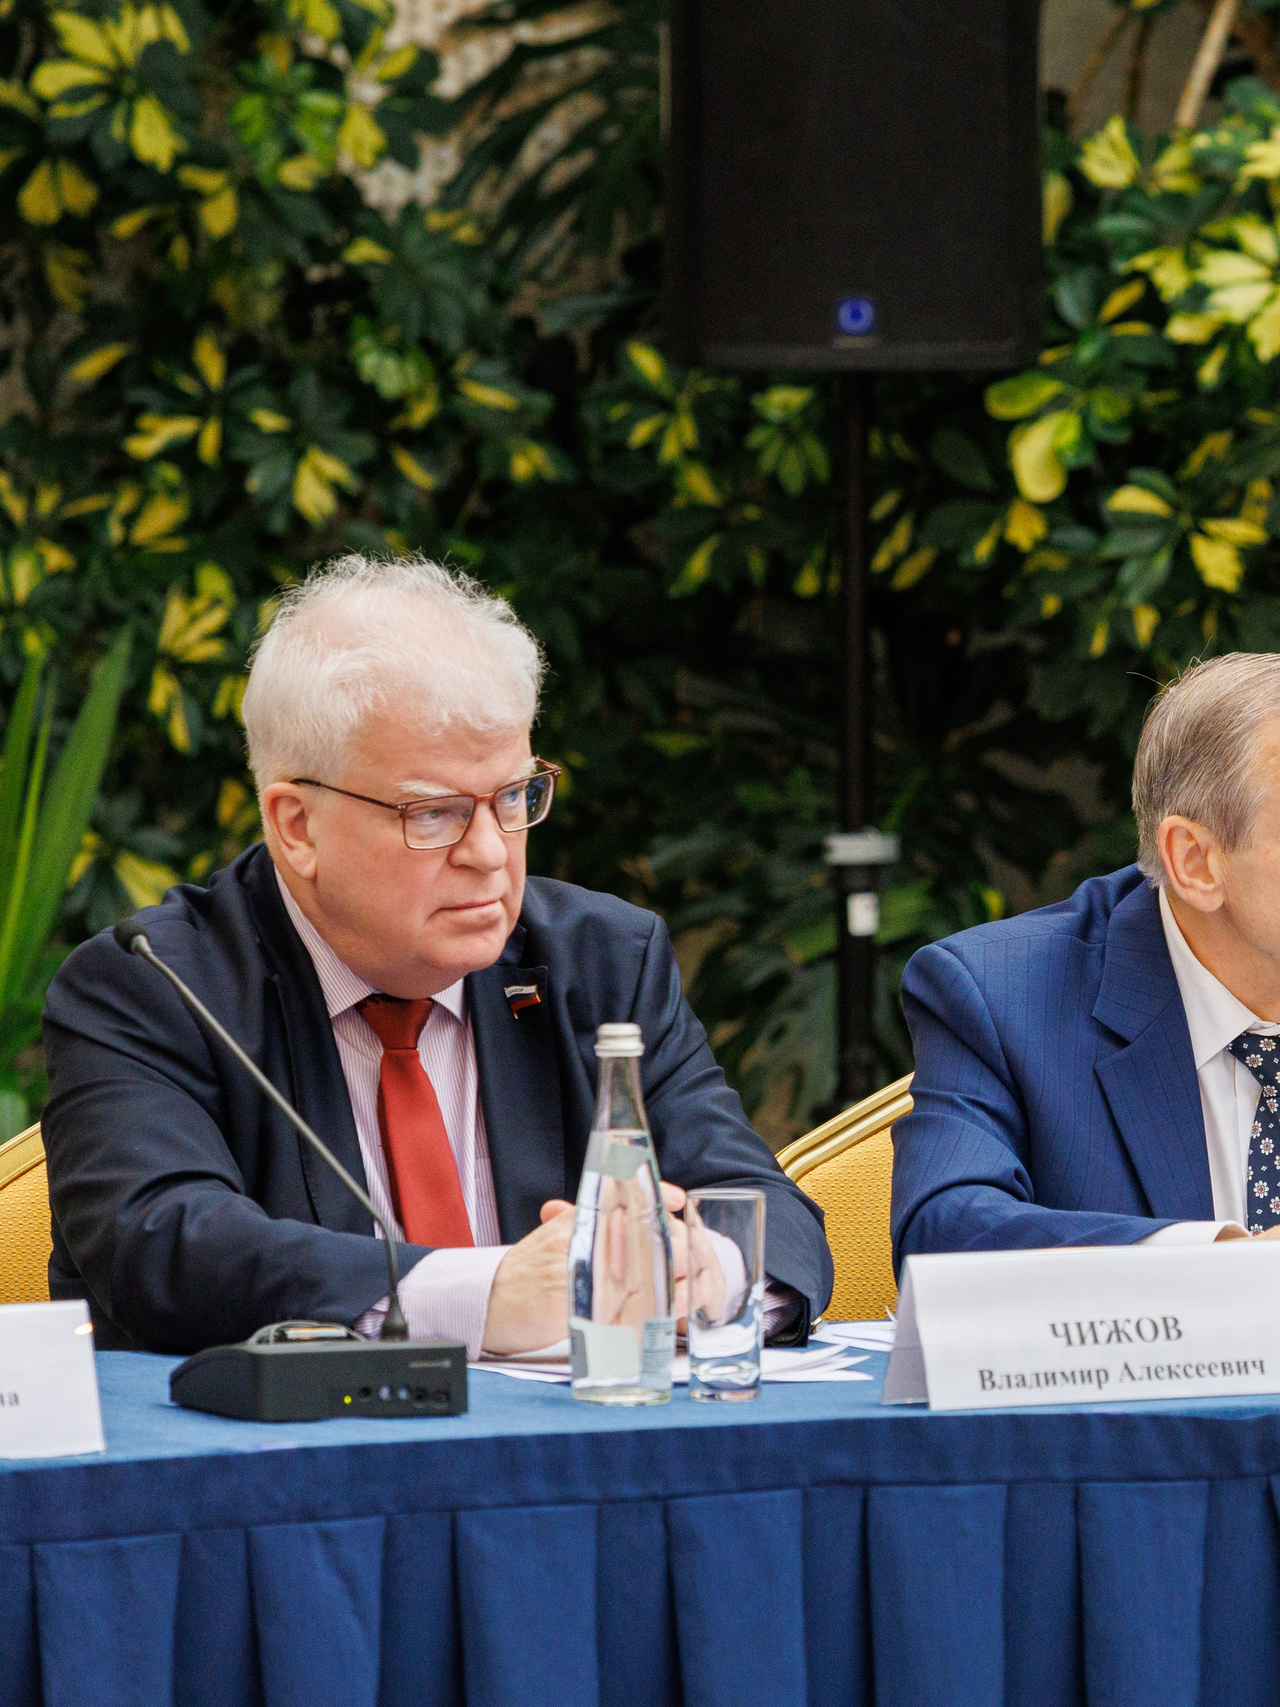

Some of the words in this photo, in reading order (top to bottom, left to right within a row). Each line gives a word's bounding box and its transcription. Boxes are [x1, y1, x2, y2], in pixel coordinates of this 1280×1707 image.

[1049, 1315, 1183, 1347] ЧИЖОВ
[978, 1367, 1110, 1392] Владимир
[1119, 1358, 1266, 1384] Алексеевич
